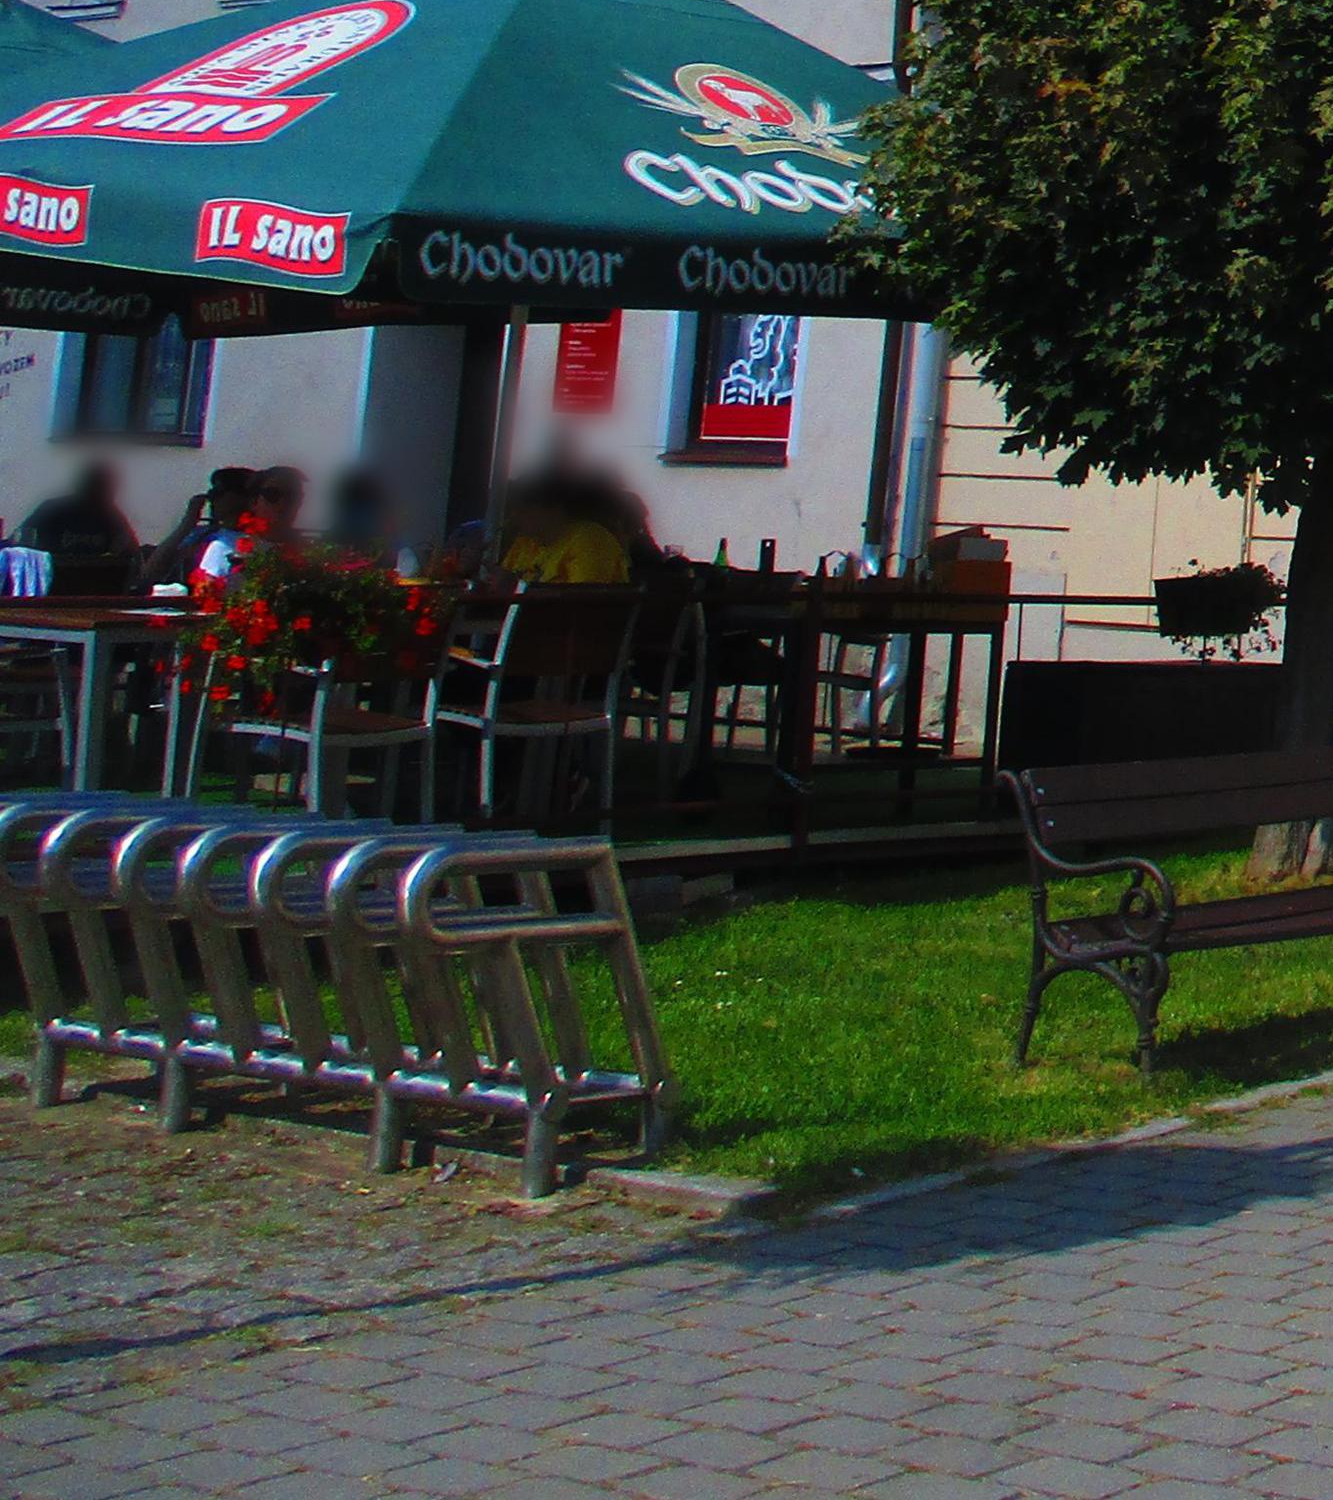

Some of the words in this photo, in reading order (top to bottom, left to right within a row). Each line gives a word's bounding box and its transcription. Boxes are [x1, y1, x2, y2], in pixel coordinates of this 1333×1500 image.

[12, 99, 109, 134] IL
[93, 99, 290, 135] sano
[4, 187, 79, 233] sano
[208, 205, 243, 248] IL
[251, 212, 336, 263] sano
[419, 230, 624, 287] Chodovar
[678, 245, 856, 299] Chodovar
